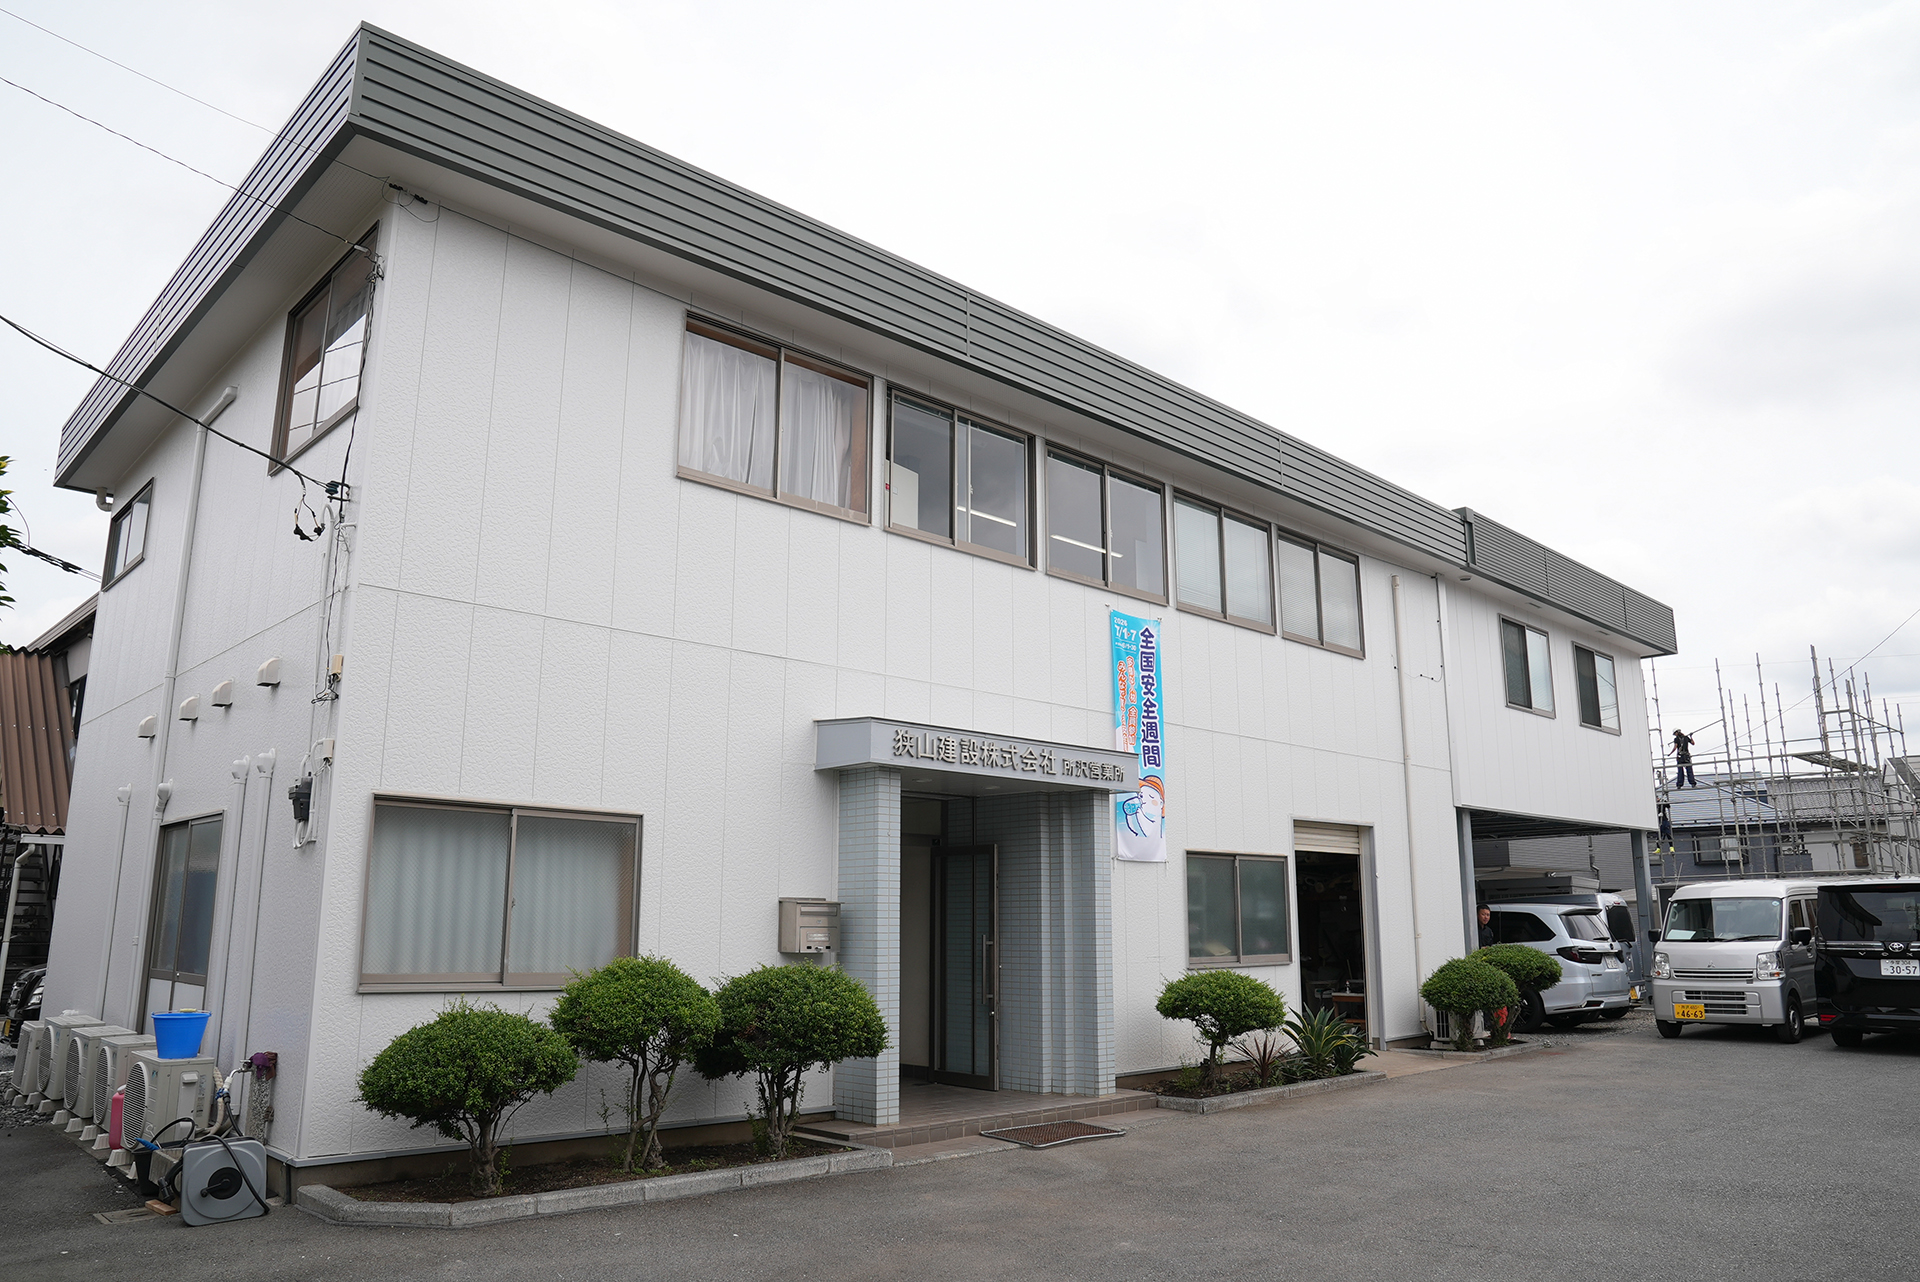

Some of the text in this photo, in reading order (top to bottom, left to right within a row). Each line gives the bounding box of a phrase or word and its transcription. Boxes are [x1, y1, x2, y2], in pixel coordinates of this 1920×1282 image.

[1140, 627, 1161, 767] 全国安全週間
[893, 729, 1126, 783] 狭山建設株式会社 所沢営業所
